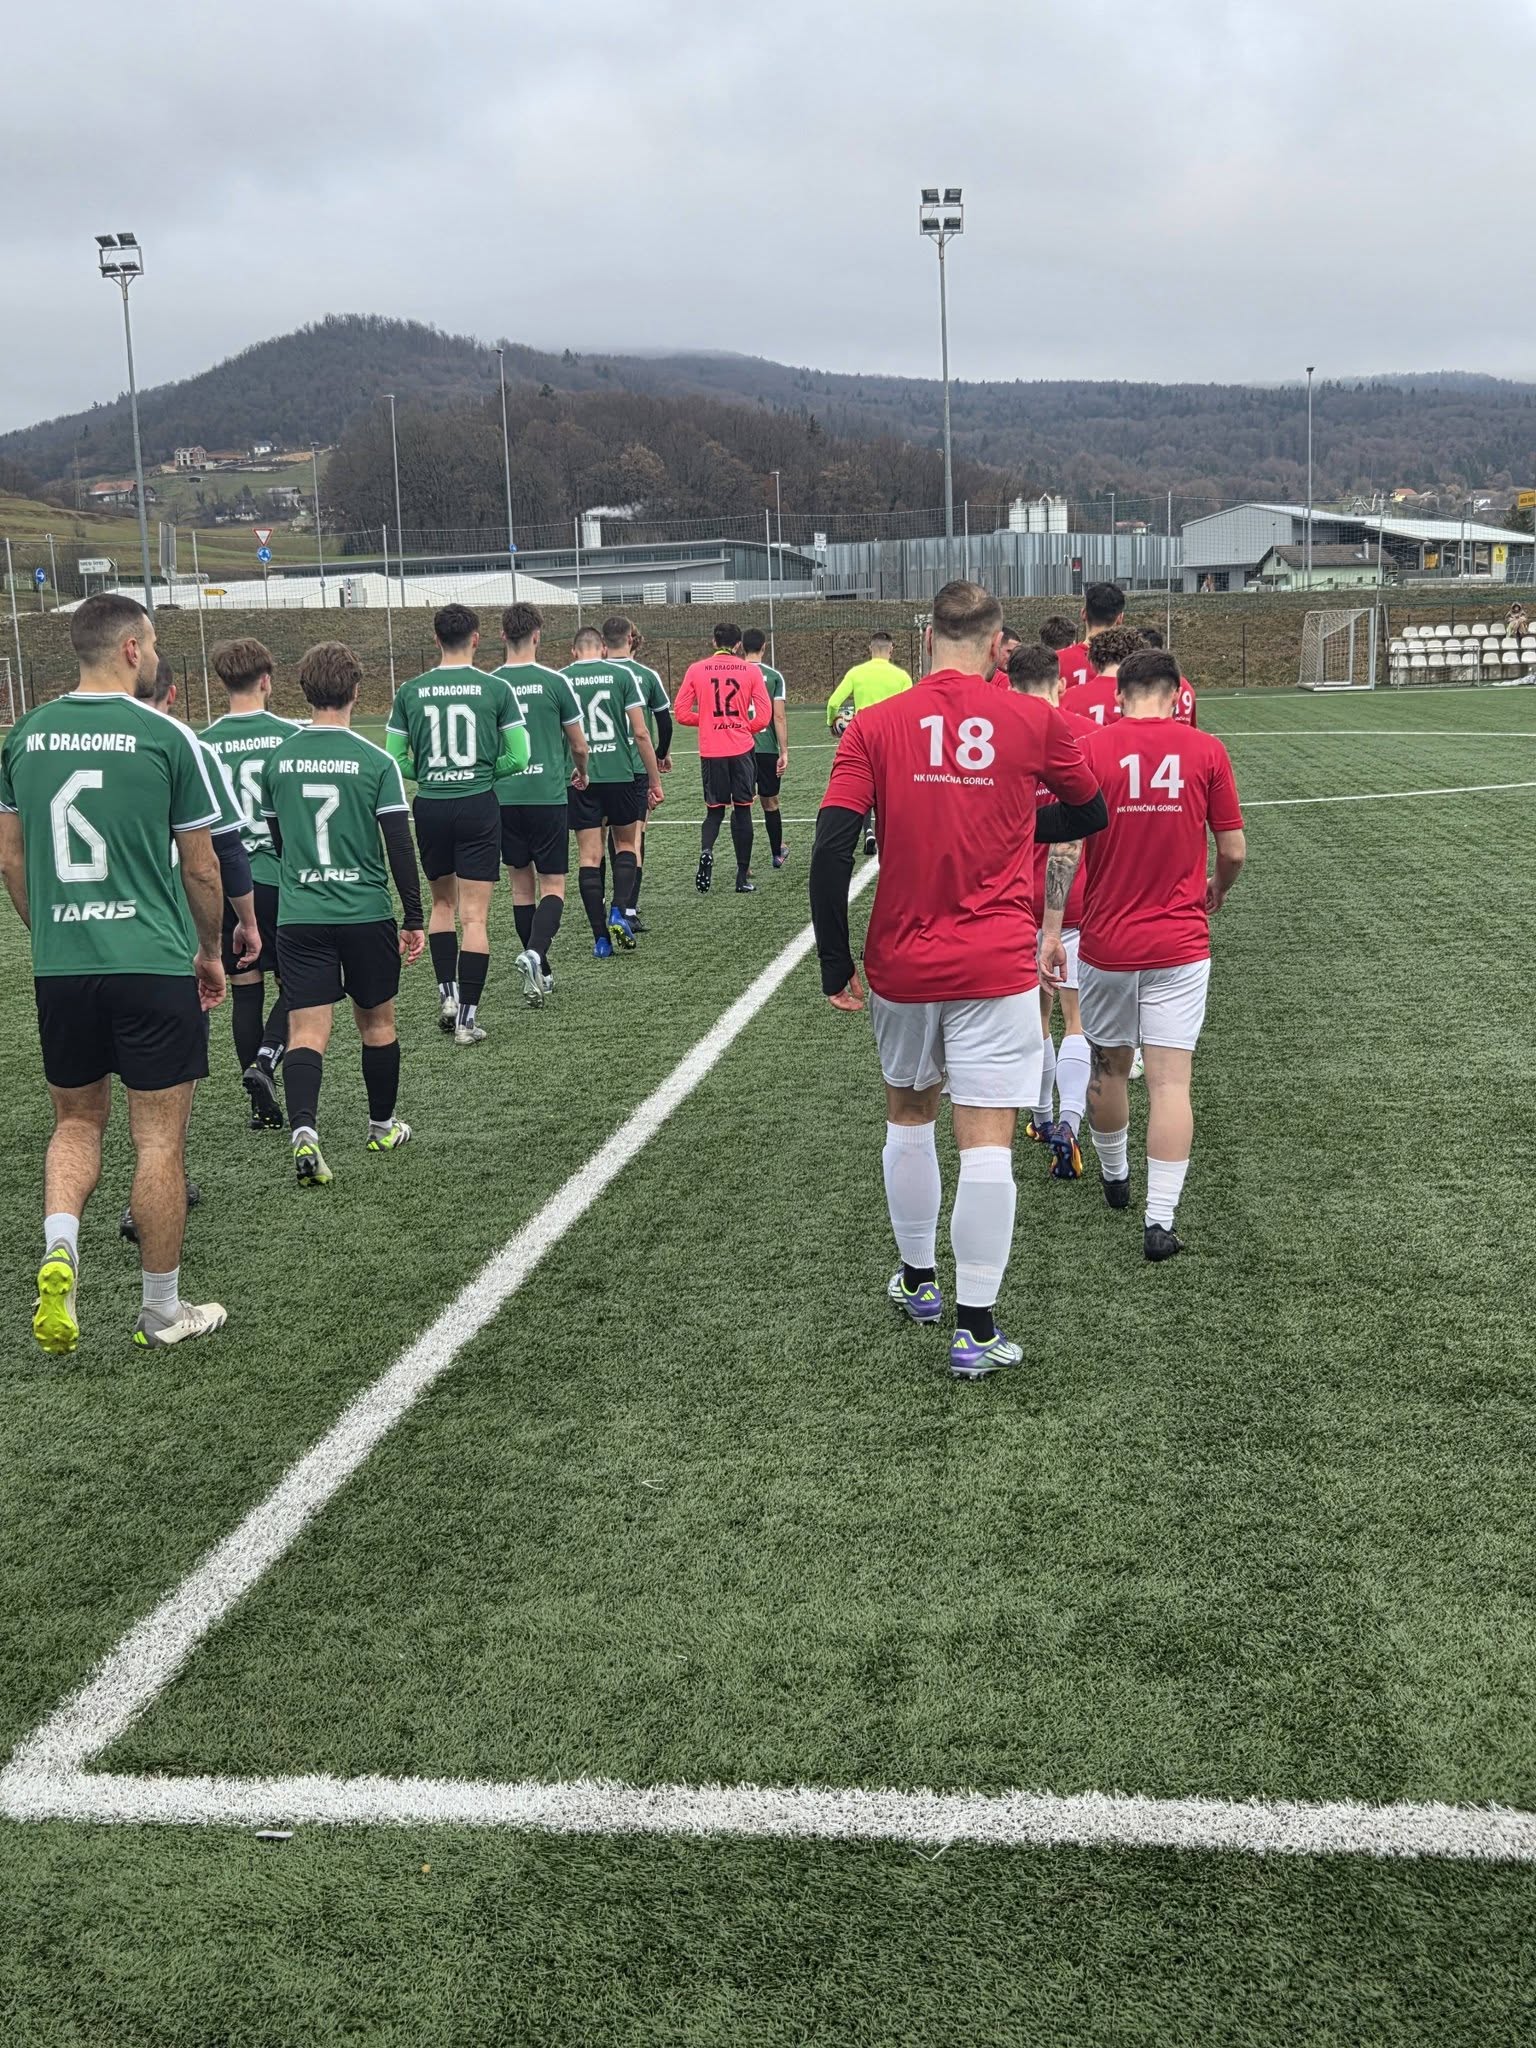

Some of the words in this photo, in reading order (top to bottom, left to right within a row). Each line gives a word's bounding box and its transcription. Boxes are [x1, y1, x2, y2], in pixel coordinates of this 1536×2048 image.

[714, 664, 747, 672] DRAGOMER
[575, 675, 614, 686] DRAGOMER
[418, 687, 431, 698] NK
[432, 685, 482, 696] DRAGOMER
[512, 684, 543, 696] GOMER
[711, 678, 740, 717] 12
[1175, 691, 1192, 715] 9
[26, 733, 46, 752] NK
[50, 733, 137, 753] DRAGOMER
[424, 704, 476, 768] 10
[920, 715, 995, 770] 18
[225, 737, 283, 752] DRAGOMER
[587, 742, 617, 754] ARIS
[279, 760, 294, 773] NK
[296, 759, 360, 775] DRAGOMER
[427, 768, 476, 782] TARIS
[913, 774, 926, 782] NK
[926, 773, 961, 784] IVANČNA
[962, 776, 995, 786] GORICA
[1119, 754, 1184, 799] 14
[1117, 806, 1126, 814] NK
[1126, 804, 1156, 813] IVANČNA
[1157, 804, 1183, 813] GORICA
[50, 770, 109, 883] 6
[302, 784, 339, 866] 7
[298, 867, 361, 884] TARIS
[51, 900, 137, 923] TARIS
